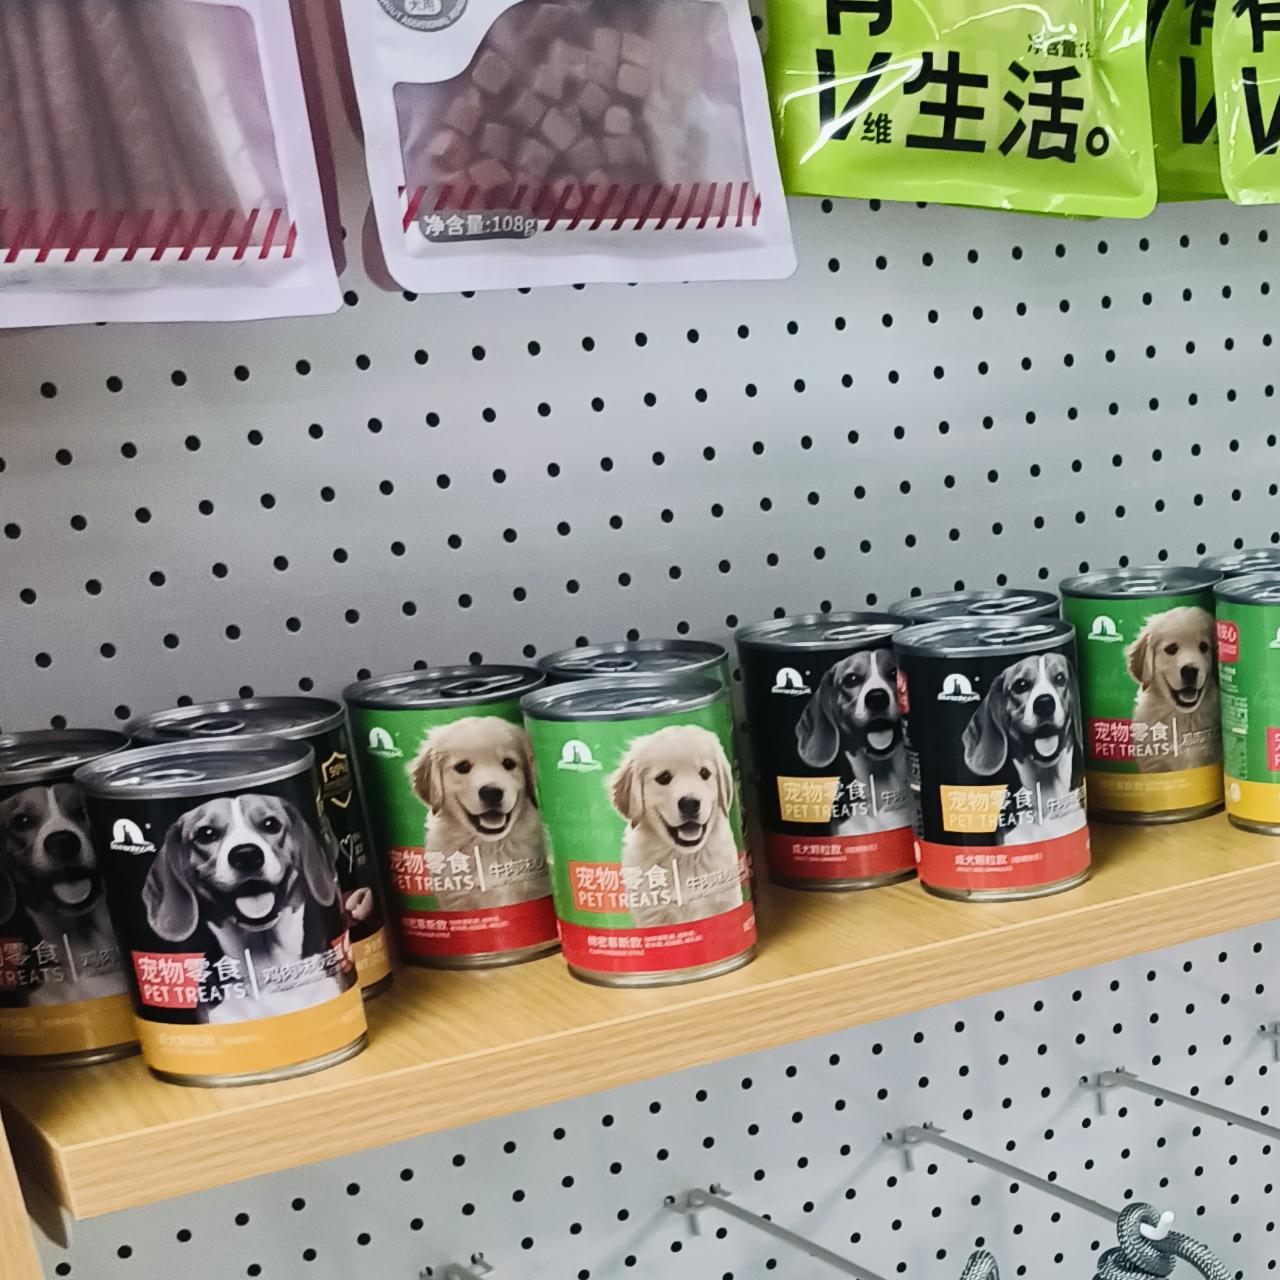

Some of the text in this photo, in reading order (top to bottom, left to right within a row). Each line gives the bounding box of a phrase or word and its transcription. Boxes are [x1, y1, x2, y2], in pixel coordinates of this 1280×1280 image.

[1094, 721, 1169, 743] 宠物零食
[1096, 742, 1170, 757] PET TREATS
[783, 779, 867, 803] 宠物零食
[948, 786, 1034, 812] 宠物零食
[785, 802, 868, 818] PET TREATS
[950, 810, 1035, 828] PET TREATS
[397, 875, 475, 892] ET TREATS
[576, 864, 669, 891] 宠物零食
[579, 890, 672, 908] PET TREATS
[138, 954, 243, 985] 宠物零食
[143, 982, 246, 1004] PET TREATS
